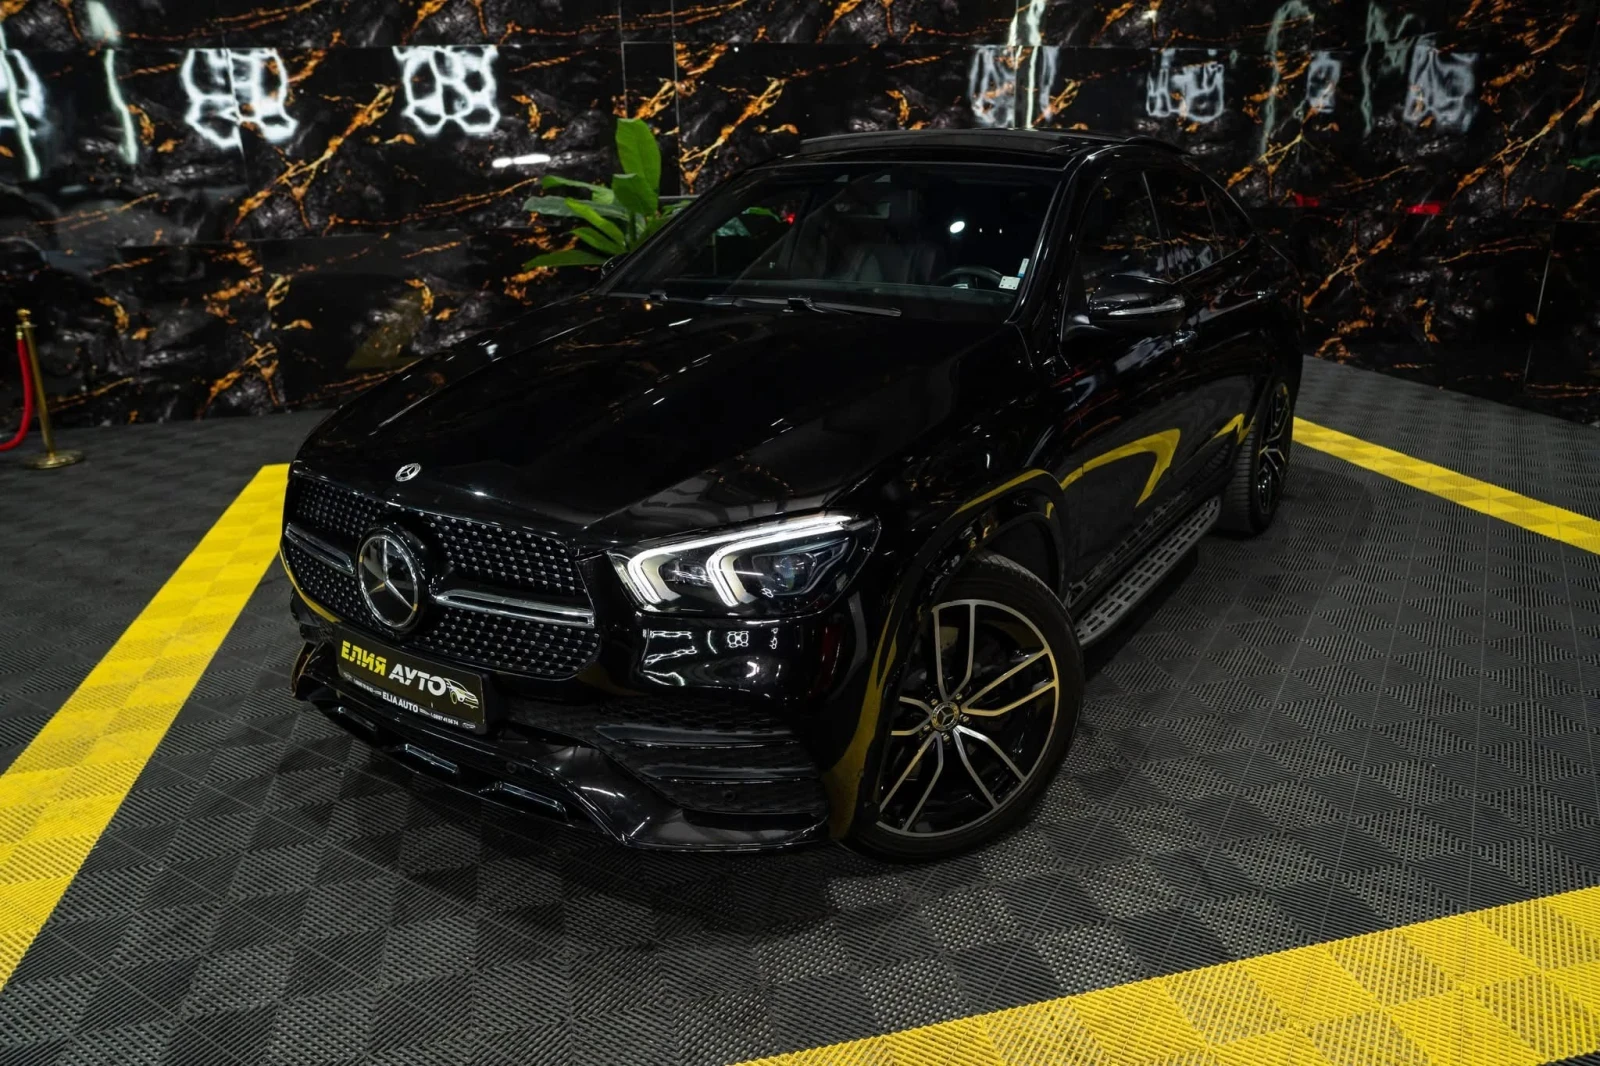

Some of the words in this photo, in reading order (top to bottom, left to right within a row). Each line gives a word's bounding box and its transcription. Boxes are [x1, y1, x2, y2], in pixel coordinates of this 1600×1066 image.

[341, 640, 387, 676] ЕЛИЯ
[389, 663, 446, 696] АУТО
[382, 691, 398, 706] ELIA
[398, 699, 419, 713] AUTO
